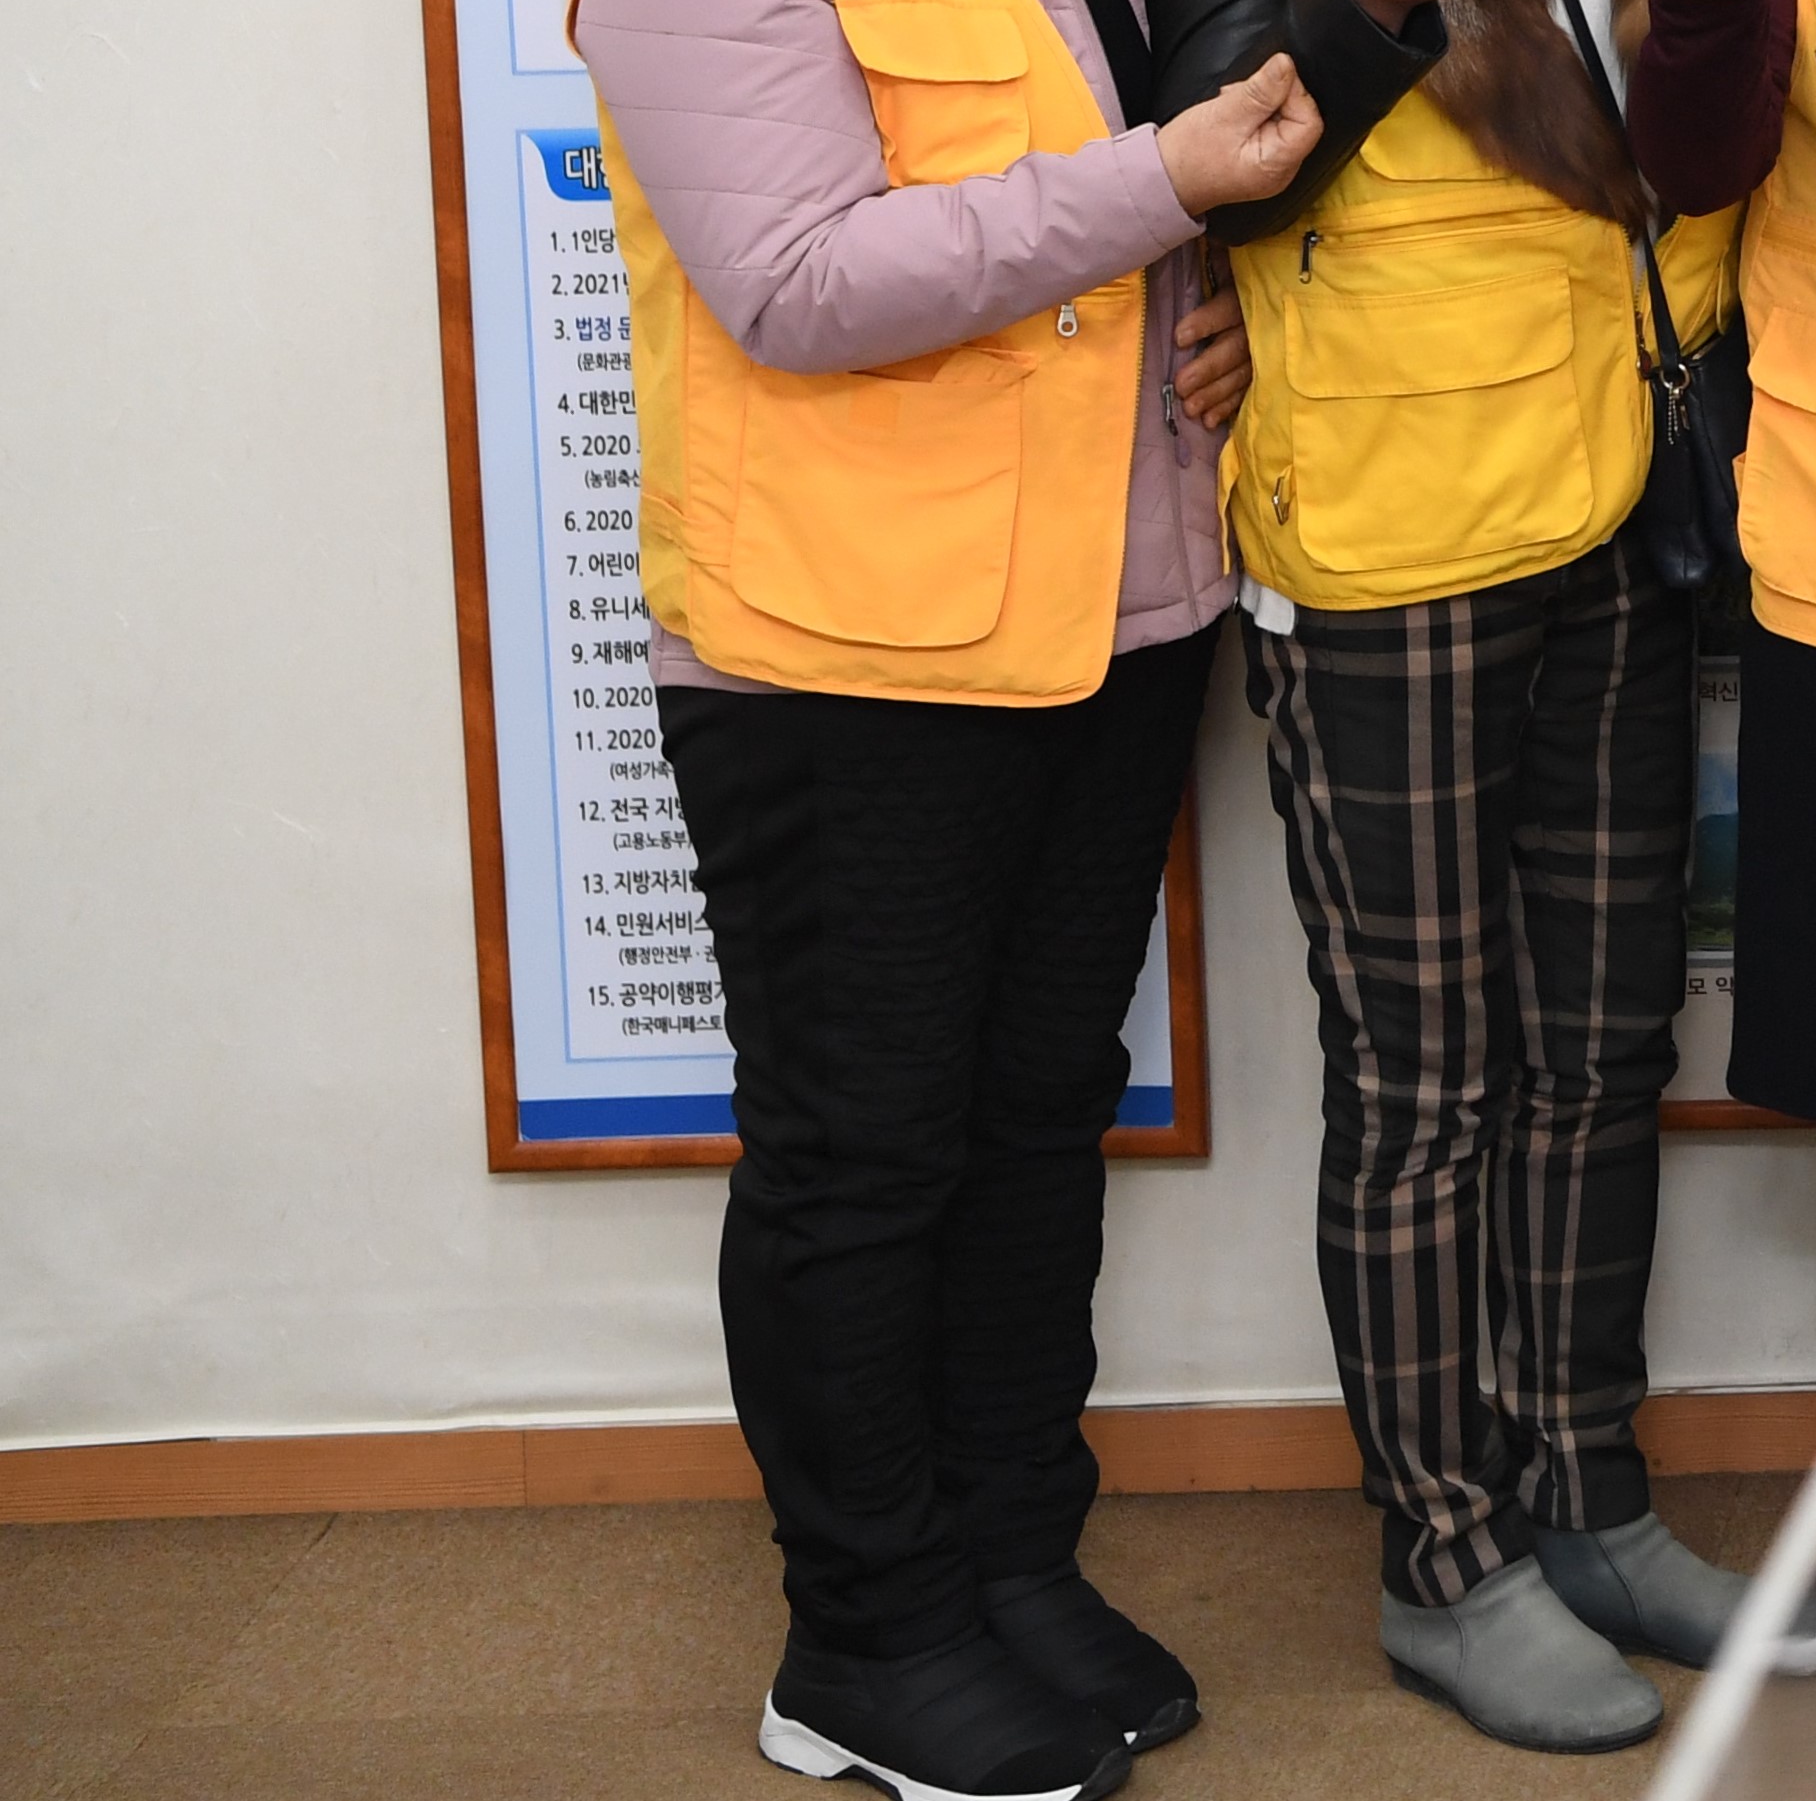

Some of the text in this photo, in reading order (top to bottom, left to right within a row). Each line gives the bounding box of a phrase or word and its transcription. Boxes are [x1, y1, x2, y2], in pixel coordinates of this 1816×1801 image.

[576, 317, 611, 341] 법정
[582, 435, 630, 456] 2020
[586, 510, 632, 531] 2020
[606, 686, 652, 707] 2020
[608, 729, 655, 750] 2020
[611, 799, 649, 822] 전국
